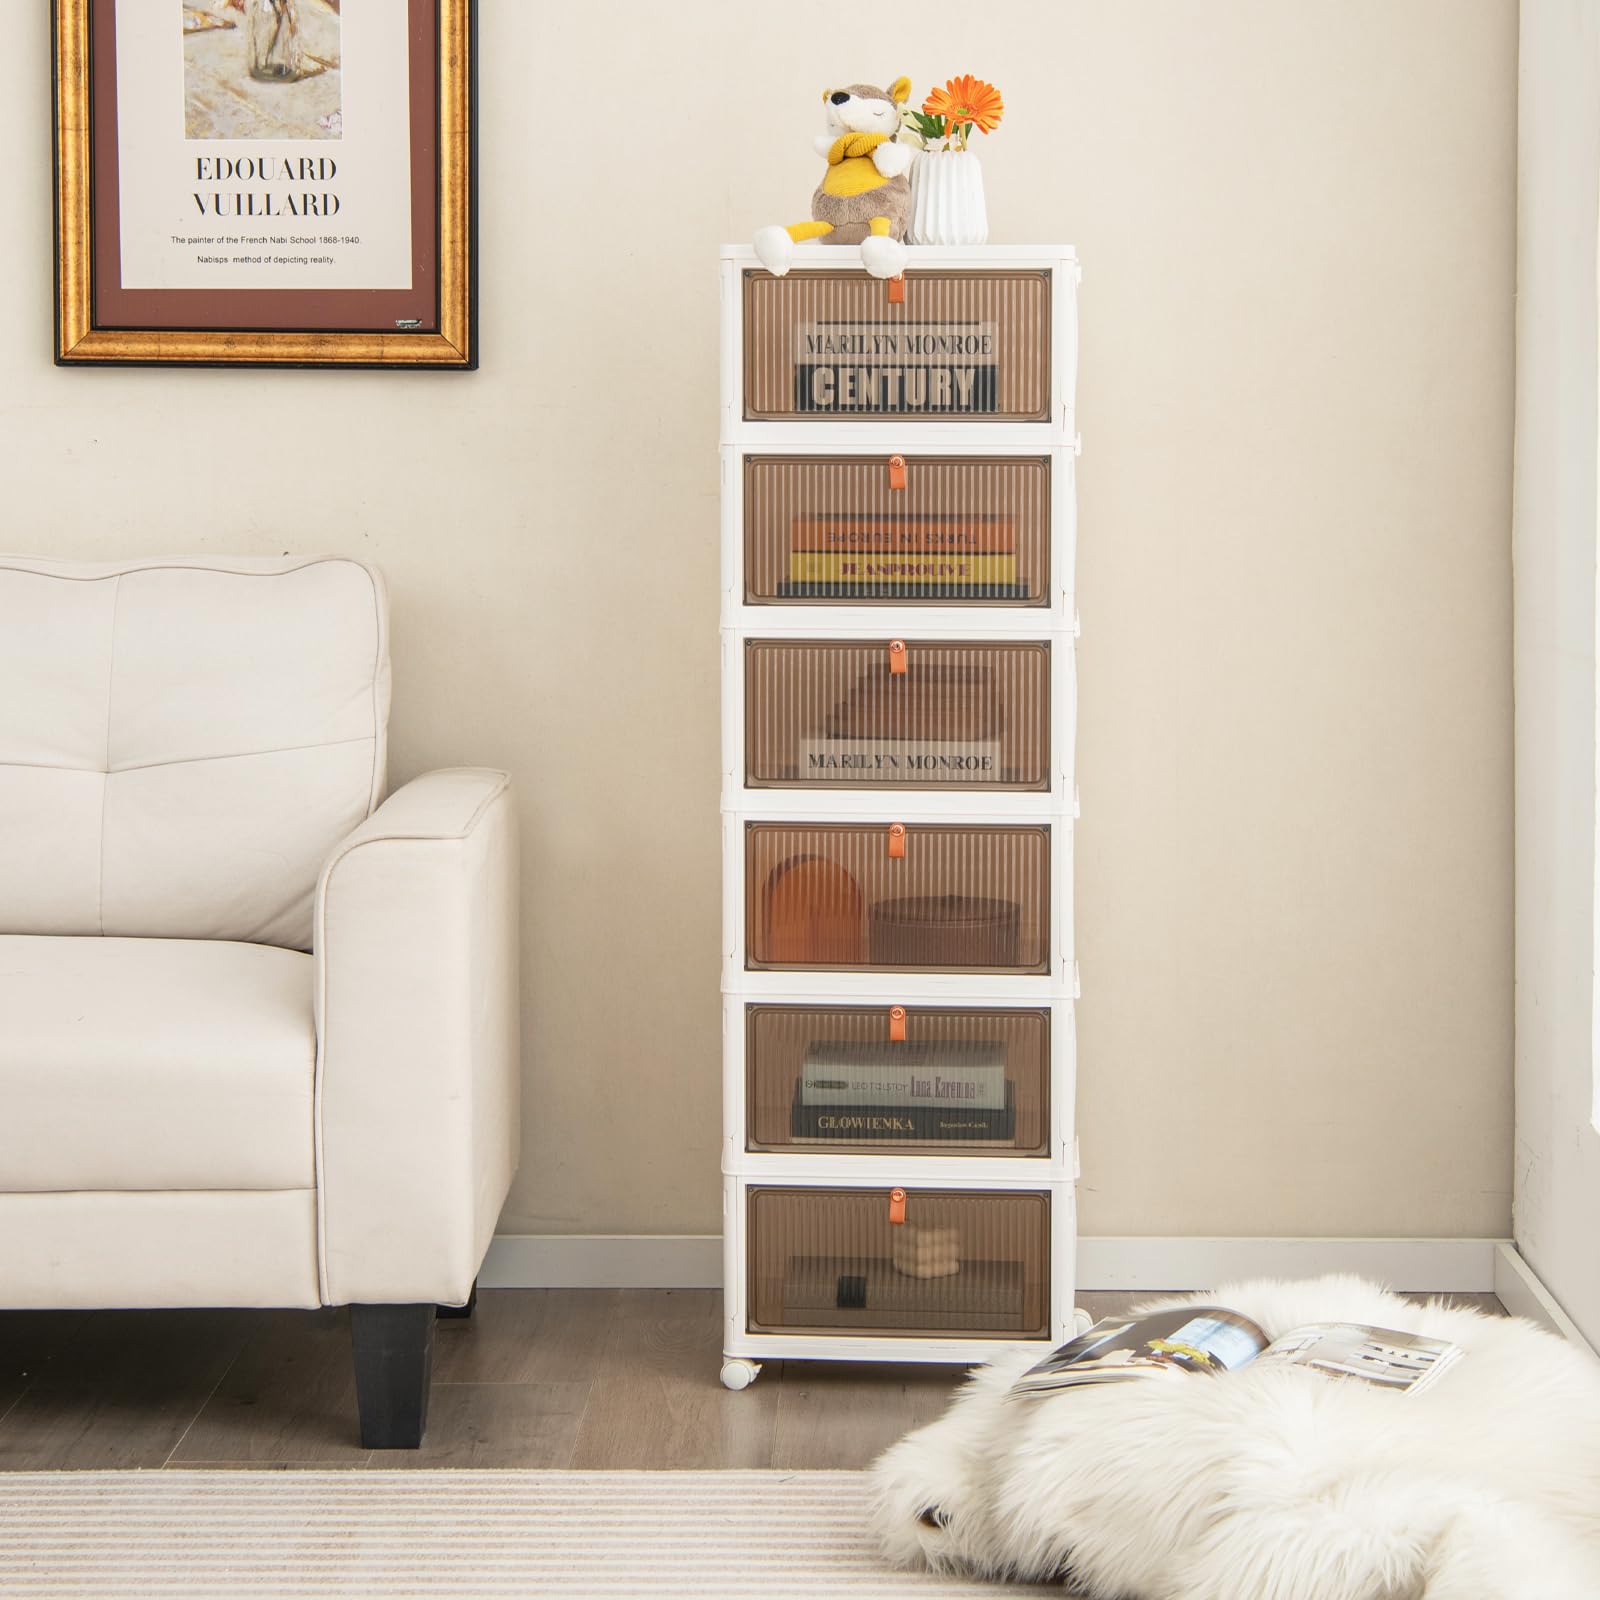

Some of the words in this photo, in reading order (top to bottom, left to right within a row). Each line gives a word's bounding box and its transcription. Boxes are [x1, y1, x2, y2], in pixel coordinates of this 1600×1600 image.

[195, 157, 337, 181] EDOUARD
[193, 192, 341, 217] VUILLARD
[171, 236, 186, 244] The
[187, 236, 215, 245] painter
[216, 236, 225, 244] of
[226, 236, 239, 244] the
[240, 236, 268, 244] French
[269, 236, 288, 244] Nabi
[289, 236, 317, 244] School
[197, 256, 229, 265] Nabisps
[232, 256, 262, 264] method
[263, 256, 272, 264] of
[273, 256, 308, 266] depicting
[310, 256, 336, 265] reality.
[806, 334, 898, 355] MARILYN
[904, 334, 993, 355] MONROE
[812, 366, 977, 406] CENTURY
[807, 753, 900, 769] MARILYN
[906, 755, 993, 771] MONROE
